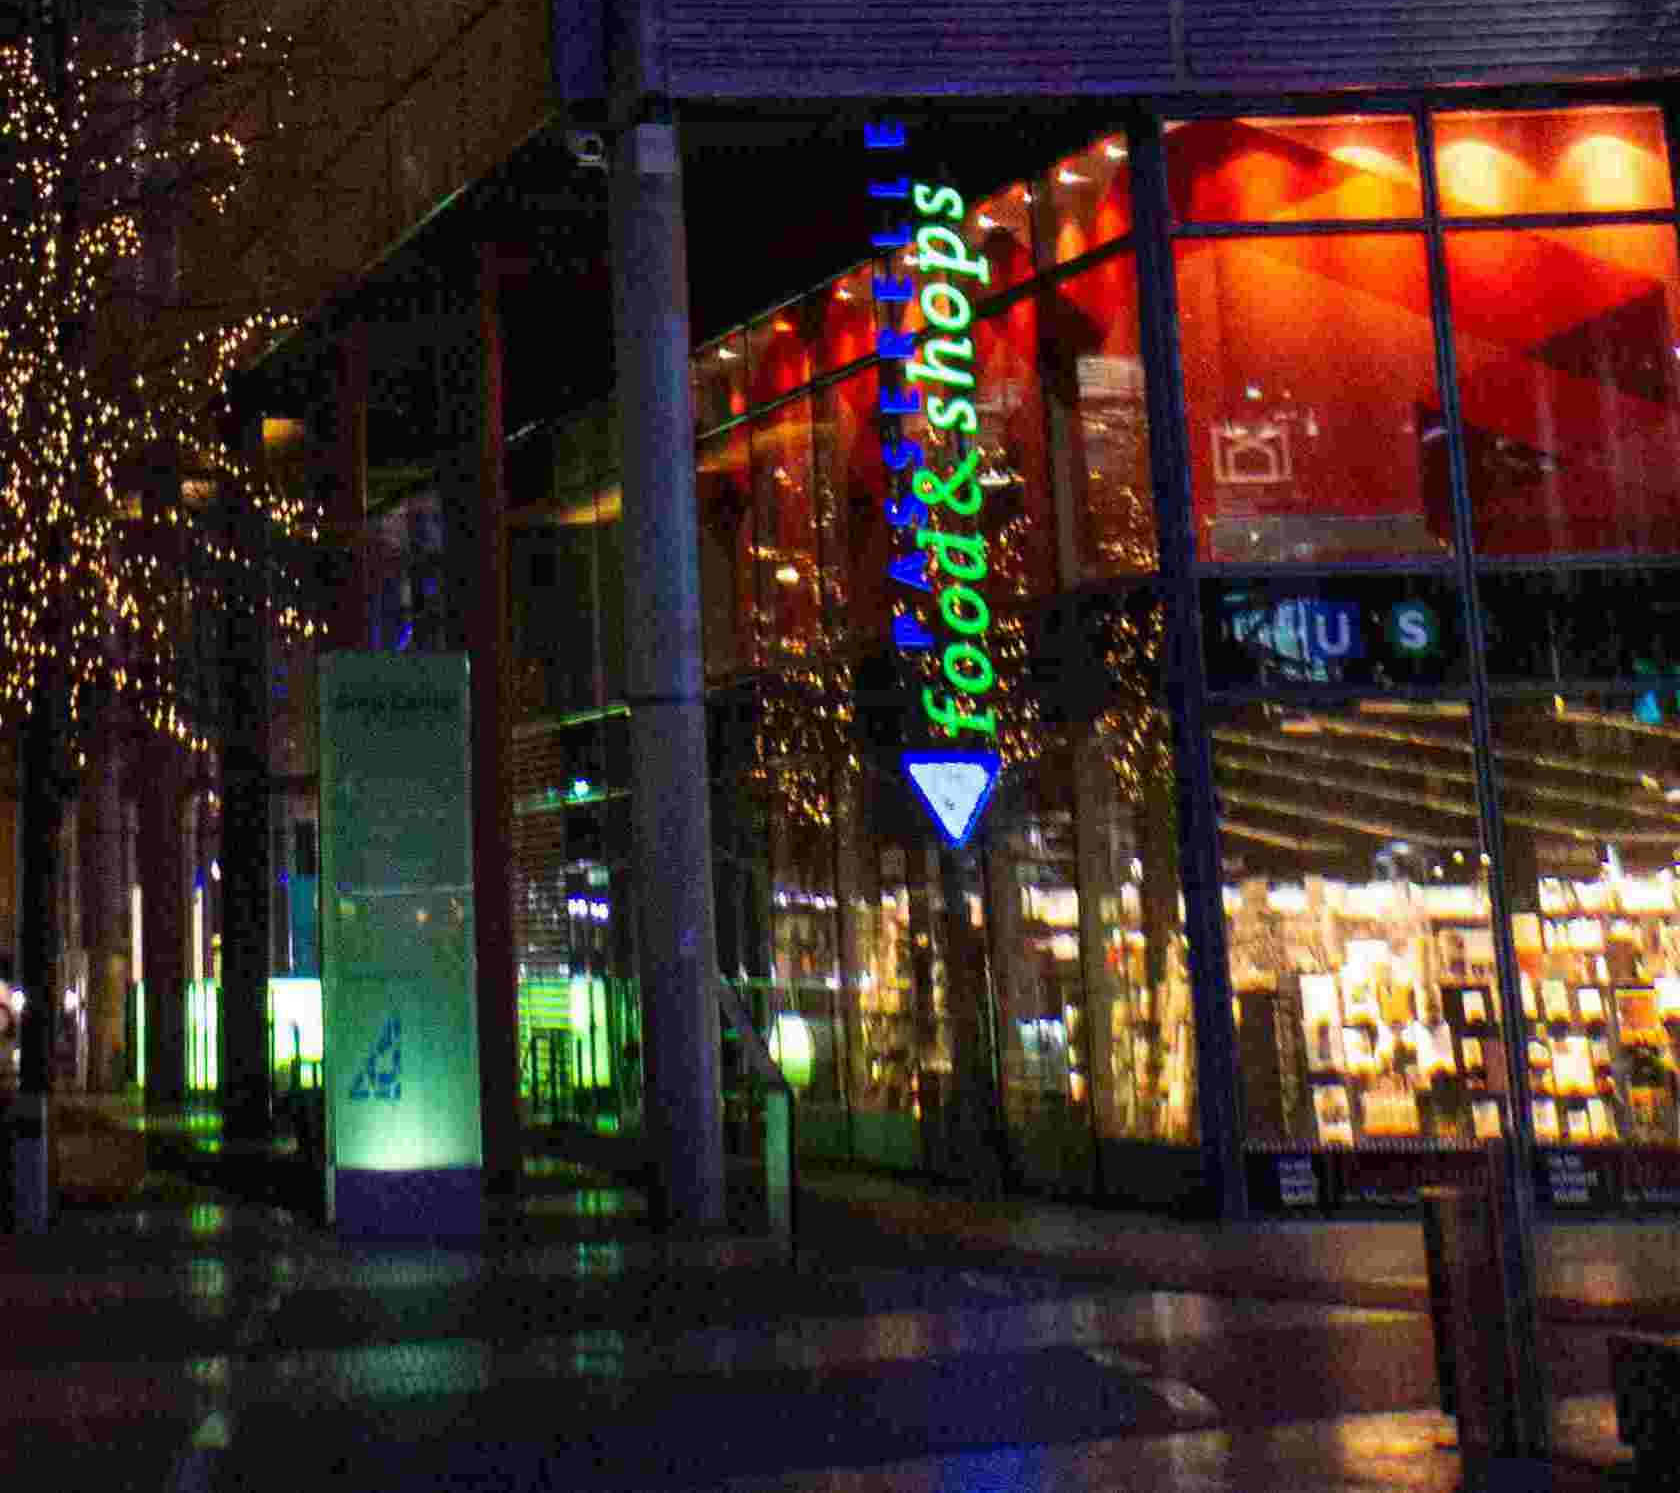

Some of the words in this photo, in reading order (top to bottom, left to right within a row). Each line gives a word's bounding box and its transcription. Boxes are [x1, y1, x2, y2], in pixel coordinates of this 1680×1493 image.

[863, 112, 936, 649] PASSERELLE
[905, 181, 993, 434] shops
[911, 446, 984, 516] &
[916, 529, 997, 739] food
